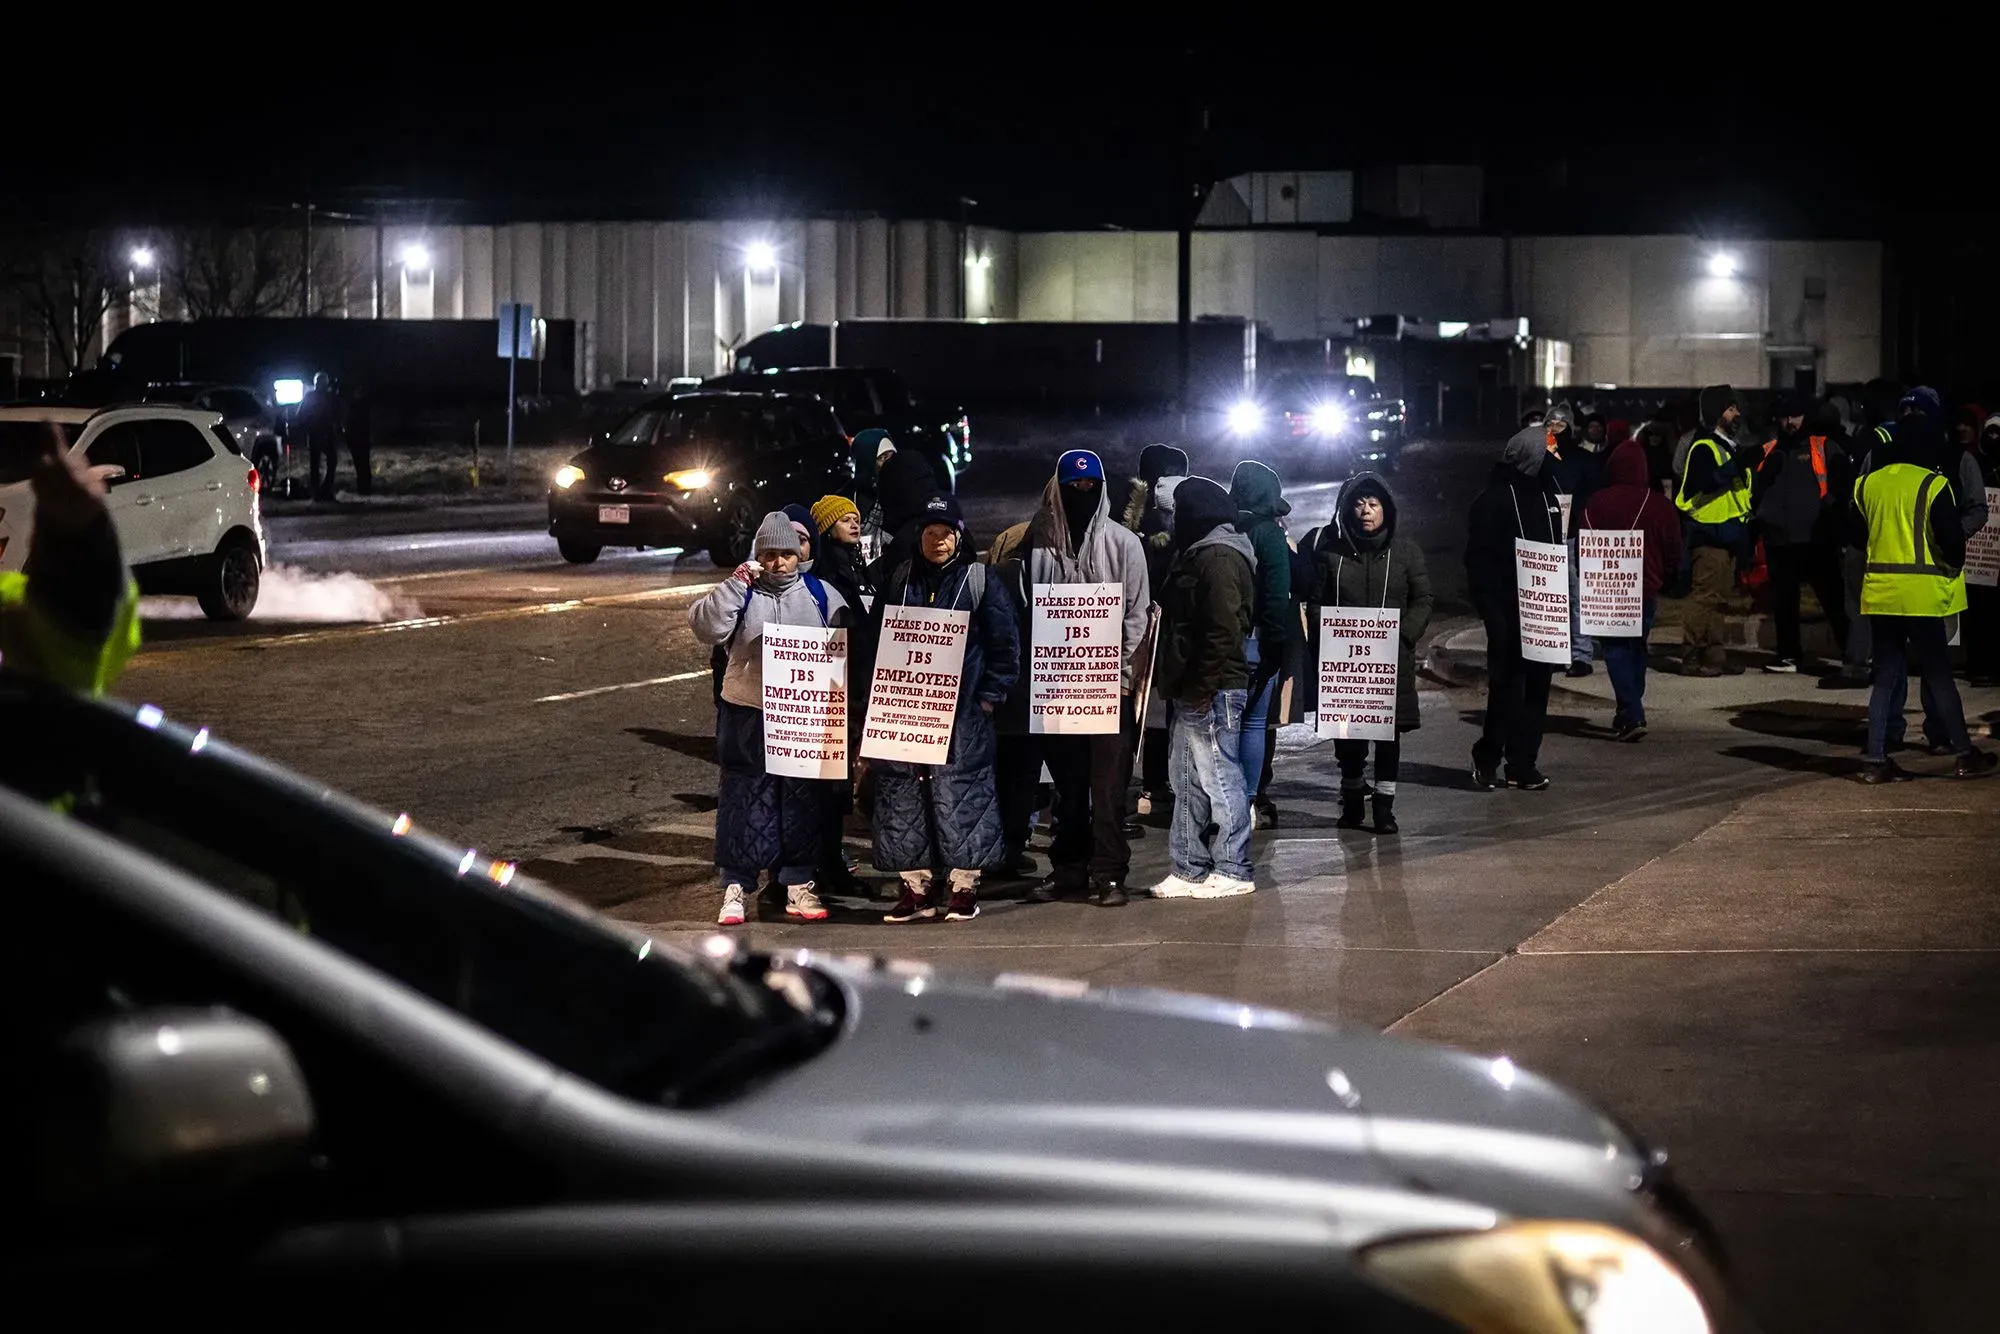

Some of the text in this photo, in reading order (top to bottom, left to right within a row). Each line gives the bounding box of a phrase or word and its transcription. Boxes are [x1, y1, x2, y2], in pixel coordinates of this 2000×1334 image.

[1075, 457, 1088, 470] C
[1581, 536, 1641, 547] FAVOR DE NO
[1538, 553, 1548, 561] DO
[1550, 555, 1566, 563] NOT
[1581, 549, 1642, 558] PRATROCINAR
[1522, 560, 1558, 572] PATRONIZE
[1603, 560, 1619, 570] JBS
[1532, 575, 1546, 586] JBS
[1584, 572, 1638, 580] EMPLEADOS
[1035, 597, 1120, 606] PLEASE DO NOT
[1047, 609, 1108, 618] PATRONIZE
[1546, 605, 1568, 613] LABOR
[1323, 618, 1357, 627] PLEASE
[1377, 620, 1398, 628] NOT
[1544, 614, 1567, 623] STRIKE
[885, 619, 966, 634] PLEASE DO NOT
[893, 632, 953, 646] PATRONIZE
[1065, 627, 1090, 641] JBS
[1333, 629, 1387, 639] PATRONIZE
[765, 636, 845, 651] PLEASE DO NOT
[1535, 639, 1557, 648] LOCAL
[774, 650, 833, 663] PATRONIZE
[1034, 646, 1119, 658] EMPLOYEES
[1349, 645, 1370, 657] JBS
[906, 650, 932, 665] JBS
[1034, 661, 1119, 670] ON UNFAIR LABOR
[1322, 662, 1396, 674] EMPLOYEES
[790, 669, 814, 683] JBS
[876, 668, 958, 687] EMPLOYEES
[1034, 674, 1118, 682] PRACTICE STRIKE
[1336, 676, 1366, 684] UNFAIR
[1369, 677, 1395, 685] LABOR
[765, 686, 845, 703] EMPLOYEES
[874, 685, 956, 700] ON UNFAIR LABOR
[1321, 686, 1394, 695] PRACTICE STRIKE
[765, 702, 845, 715] ON UNFAIR LABOR
[872, 697, 954, 711] PRACTICE STRIKE
[1033, 705, 1117, 715] UFCW LOCAL #7
[766, 714, 845, 727] PRACTICE STRIKE
[1320, 713, 1393, 724] UFCW LOCAL #7
[867, 729, 948, 745] UFCW LOCAL #7
[767, 745, 844, 760] UFCW LOCAL #7
